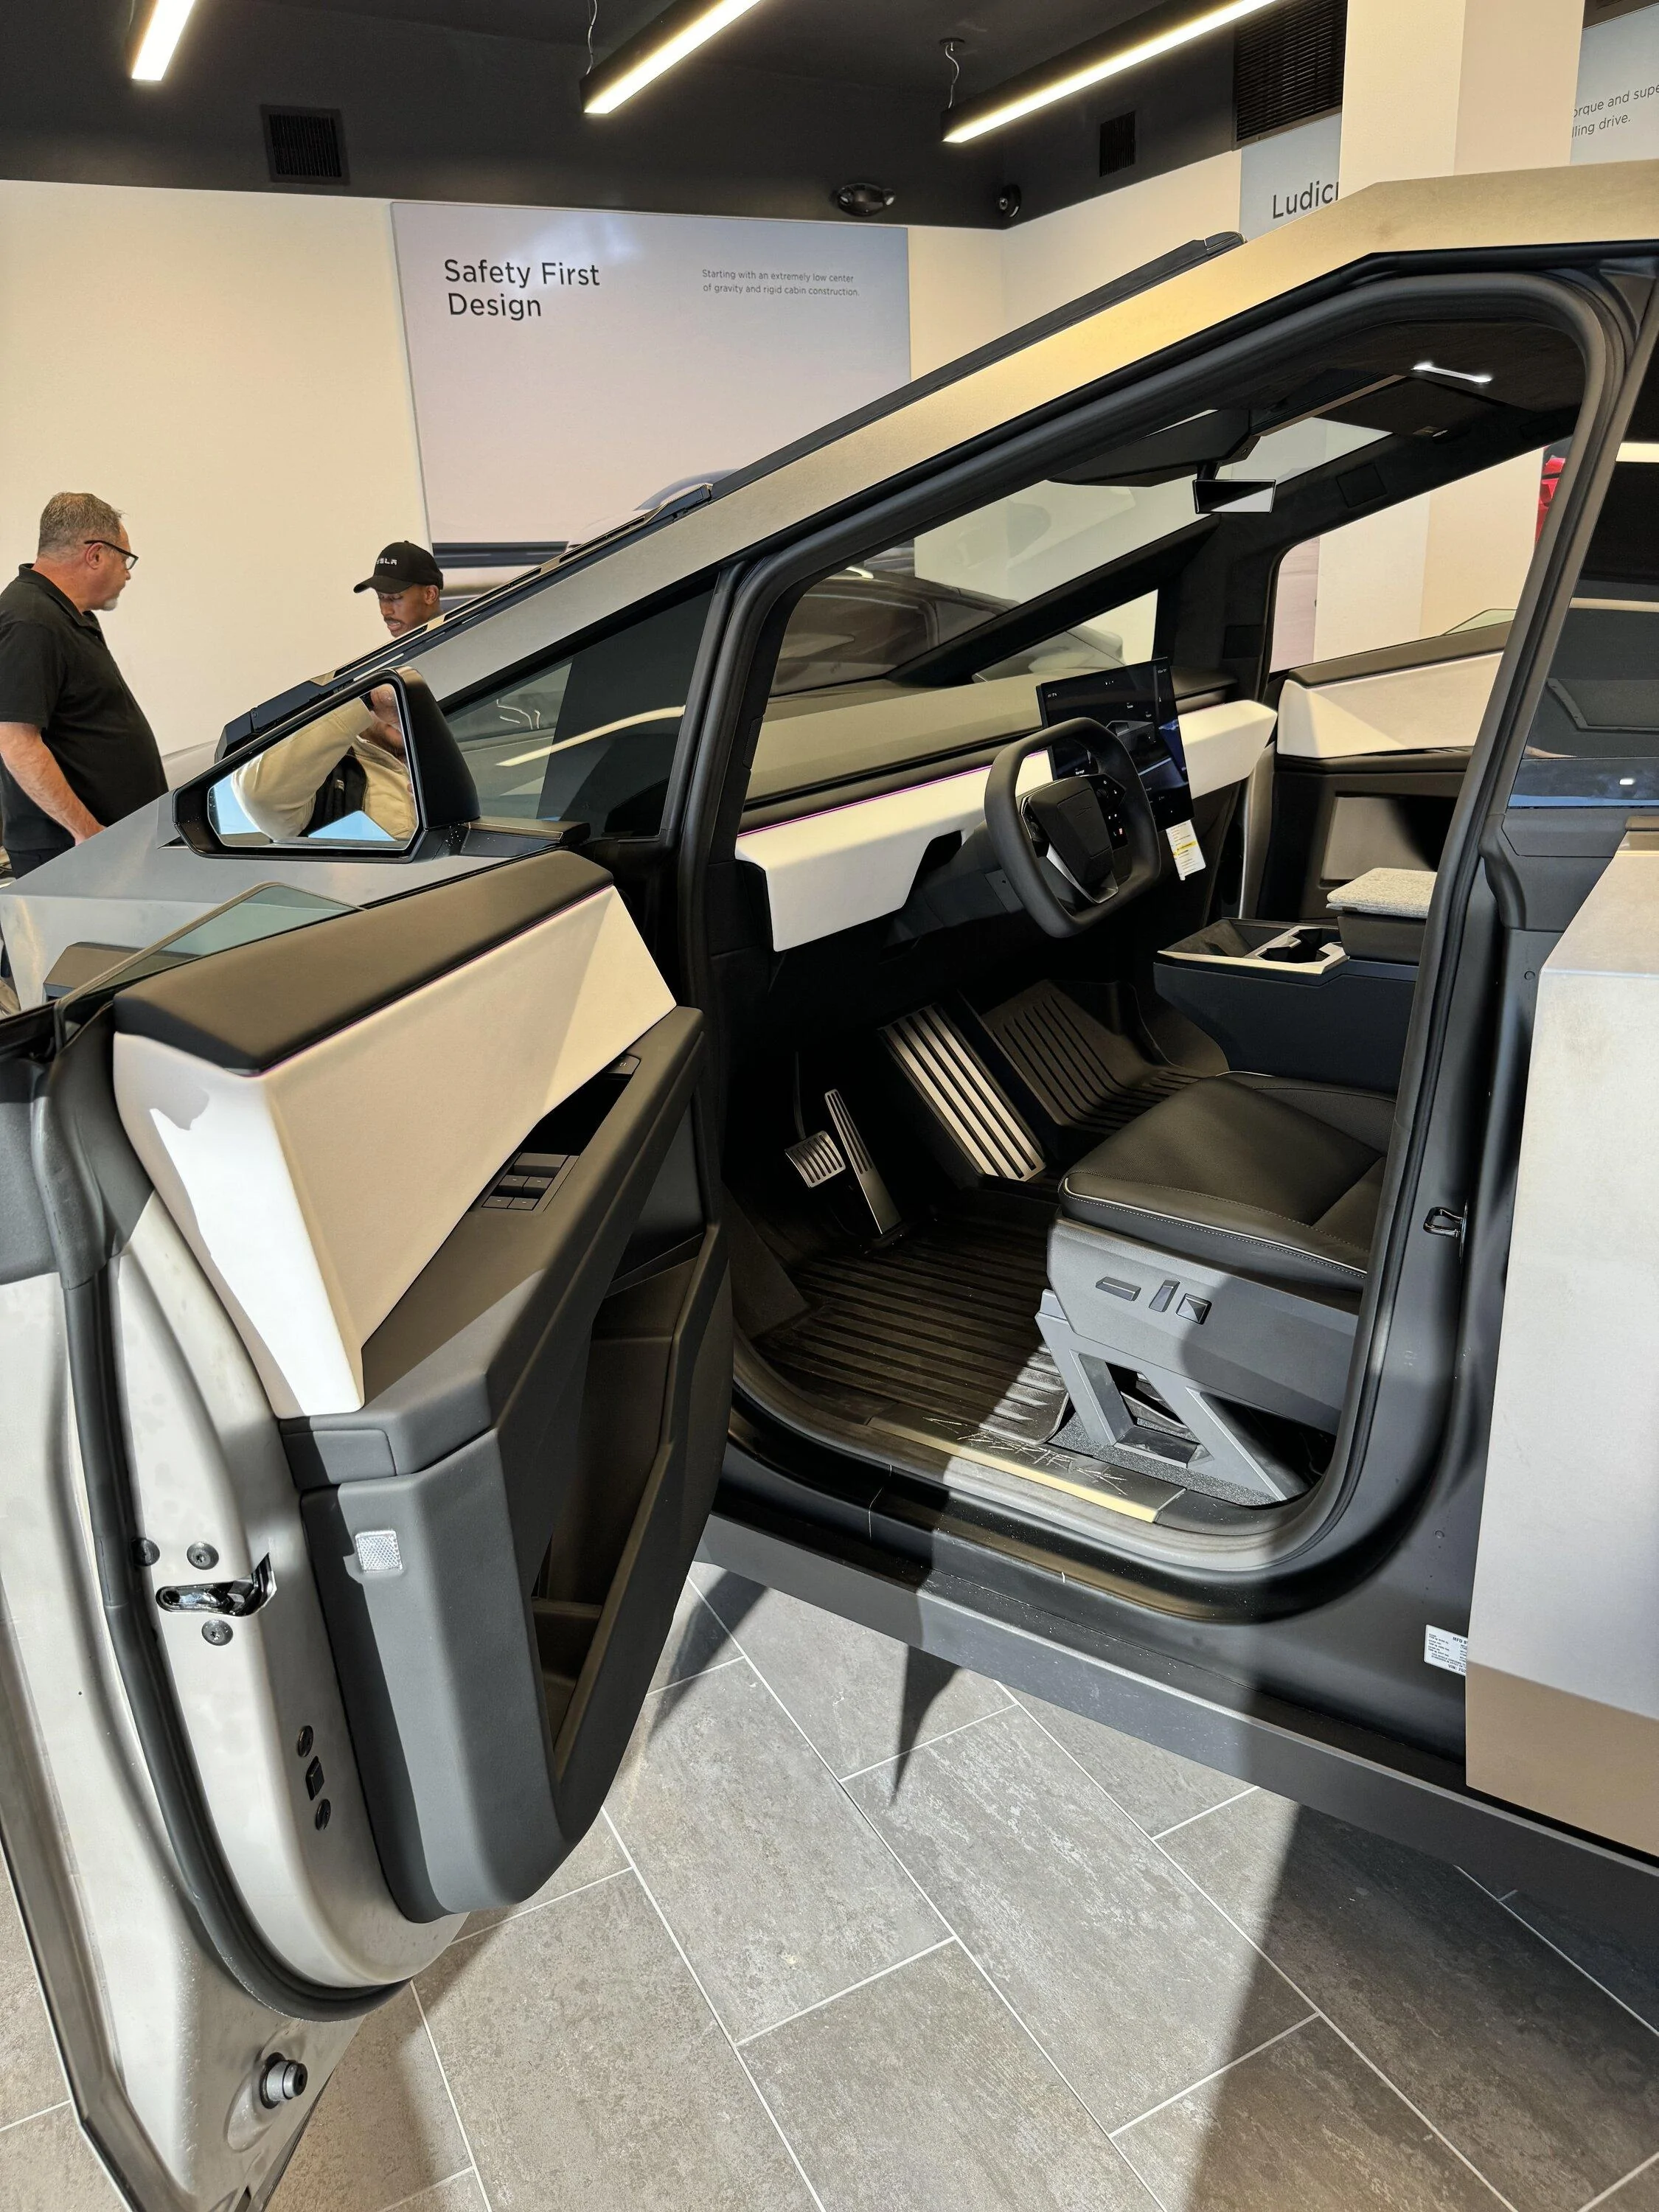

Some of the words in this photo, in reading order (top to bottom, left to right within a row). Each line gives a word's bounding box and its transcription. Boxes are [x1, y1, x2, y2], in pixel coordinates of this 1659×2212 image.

[1607, 90, 1630, 108] and
[1599, 114, 1630, 130] drive.
[445, 259, 531, 288] Safety
[541, 262, 600, 286] First
[702, 269, 736, 279] Starting
[738, 271, 757, 279] with
[771, 272, 810, 282] extremely
[813, 273, 827, 282] low
[829, 274, 854, 283] center
[703, 283, 712, 292] of
[714, 284, 743, 294] gravity
[745, 285, 761, 293] and
[763, 285, 782, 295] rigid
[785, 286, 806, 295] cabin
[808, 287, 860, 296] construction.
[448, 292, 542, 321] Design
